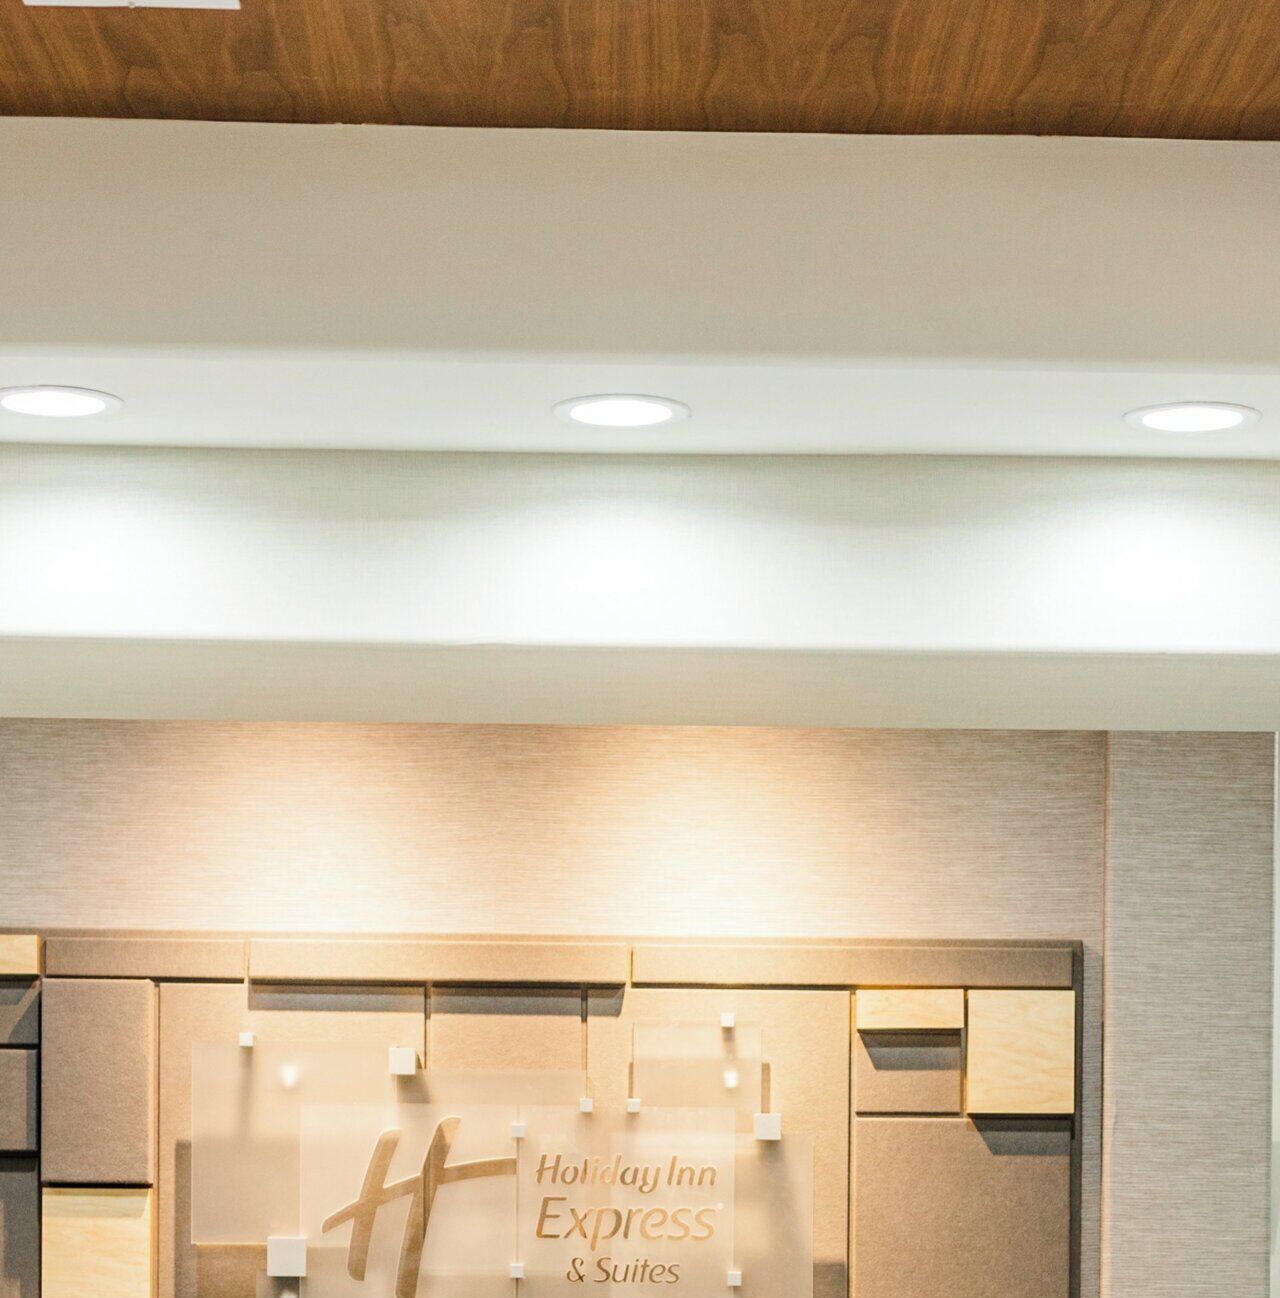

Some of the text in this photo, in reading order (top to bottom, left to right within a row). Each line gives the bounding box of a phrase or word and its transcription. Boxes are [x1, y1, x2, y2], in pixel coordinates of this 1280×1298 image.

[535, 1154, 718, 1194] Holiday Inn
[535, 1196, 717, 1252] Express
[566, 1256, 681, 1285] & Suites
